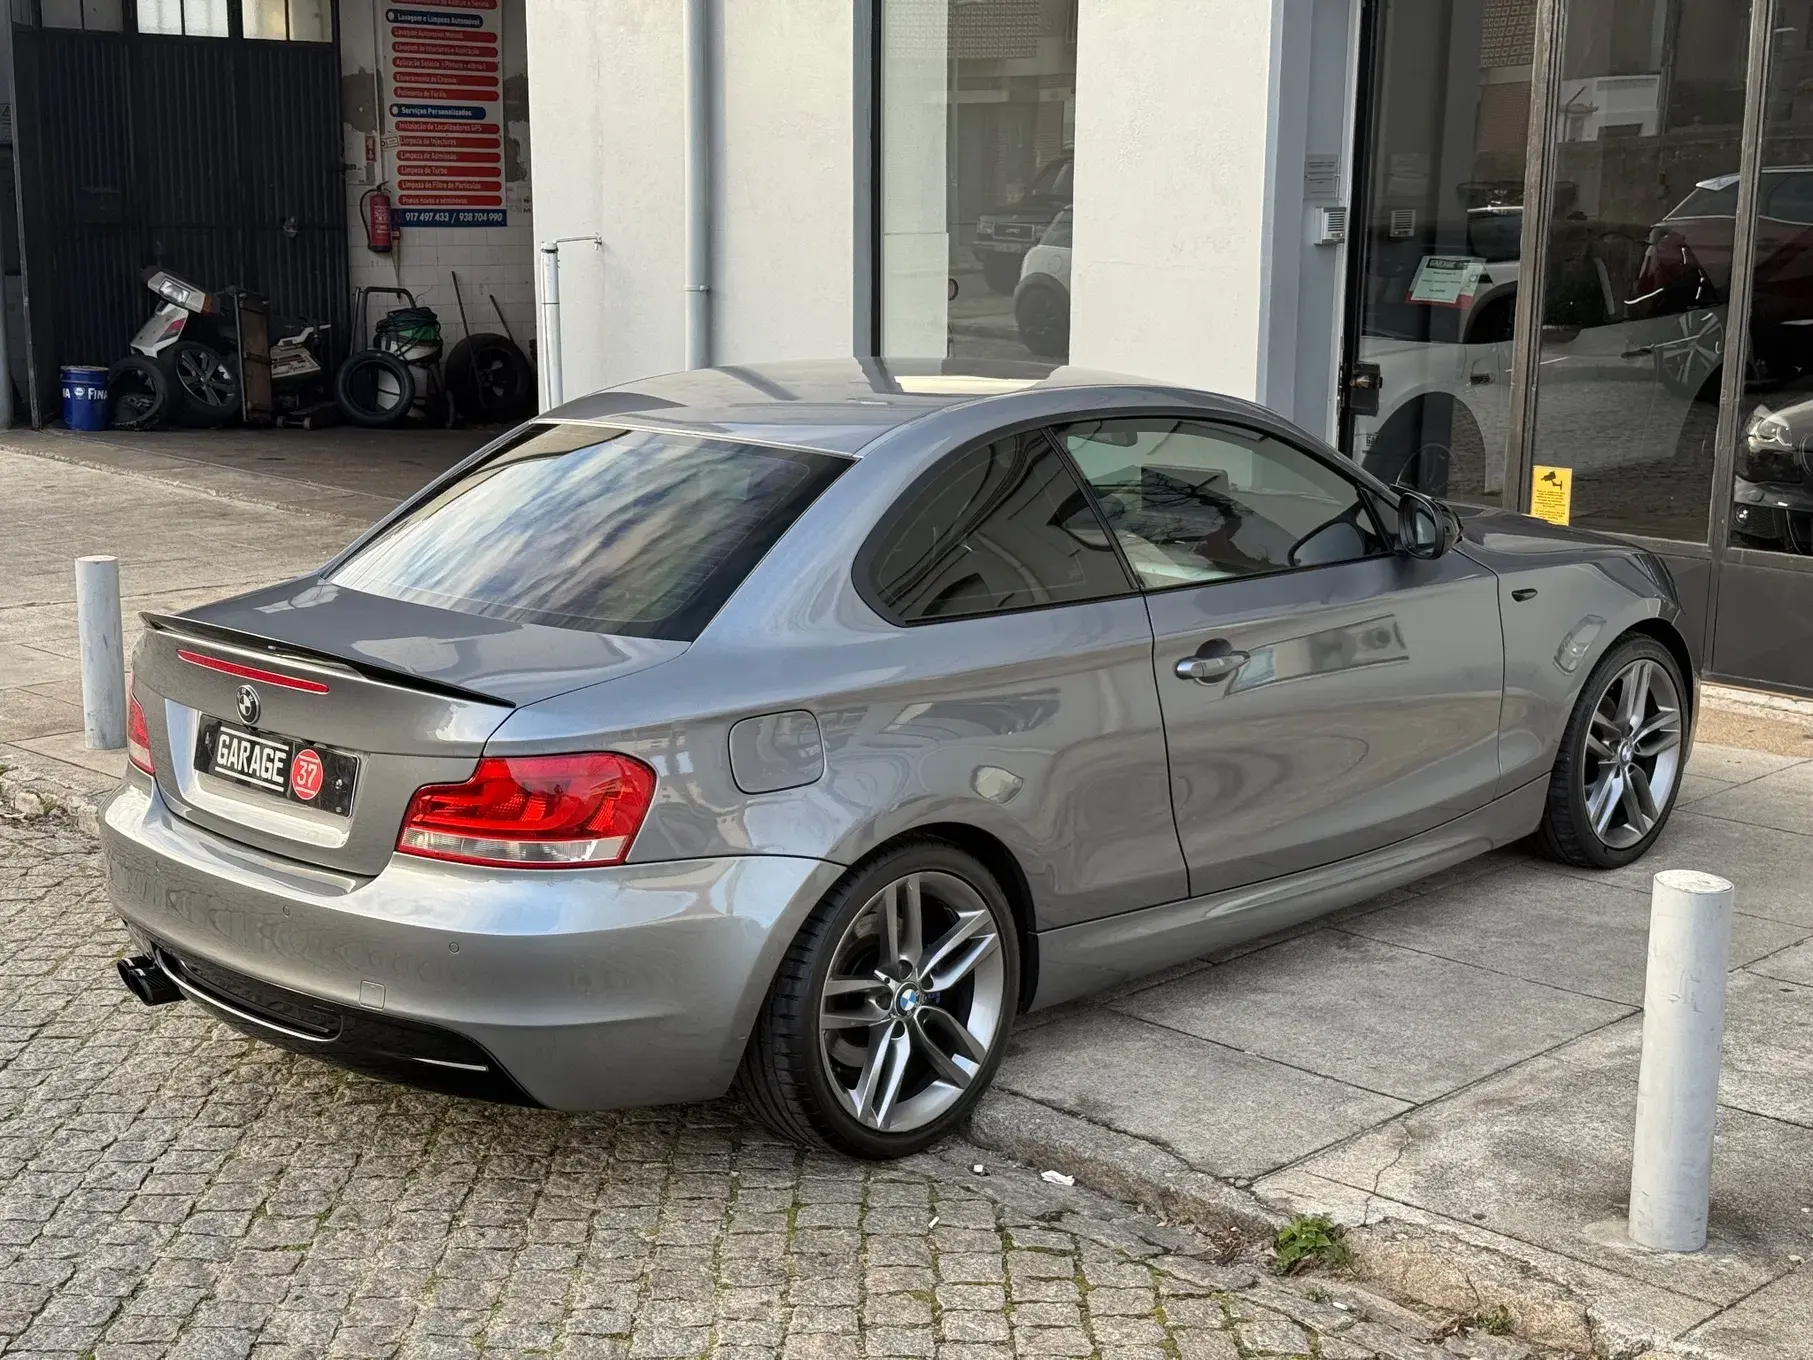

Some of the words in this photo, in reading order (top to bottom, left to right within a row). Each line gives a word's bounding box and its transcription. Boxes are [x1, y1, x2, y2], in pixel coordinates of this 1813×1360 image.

[397, 13, 422, 22] Lavagem
[428, 15, 450, 24] Limpeza
[451, 17, 480, 25] Automóvel
[394, 29, 418, 37] Lavagem
[395, 44, 418, 52] Lavagem
[396, 59, 420, 67] Aplicação
[397, 89, 422, 97] Polimento
[401, 107, 427, 116] Serviços
[428, 108, 472, 117] Personalizados
[399, 122, 427, 130] Instalação
[400, 137, 422, 145] Limpeza
[400, 152, 423, 160] Limpeza
[401, 166, 424, 175] Limpeza
[402, 181, 424, 189] Limpeza
[405, 212, 418, 222] 917
[419, 212, 433, 222] 497
[433, 213, 449, 222] 433
[459, 213, 472, 222] 938
[473, 213, 487, 222] 704
[488, 213, 503, 222] 990
[88, 387, 109, 400] FINA
[217, 734, 287, 784] GARAGE
[297, 761, 317, 787] 37
